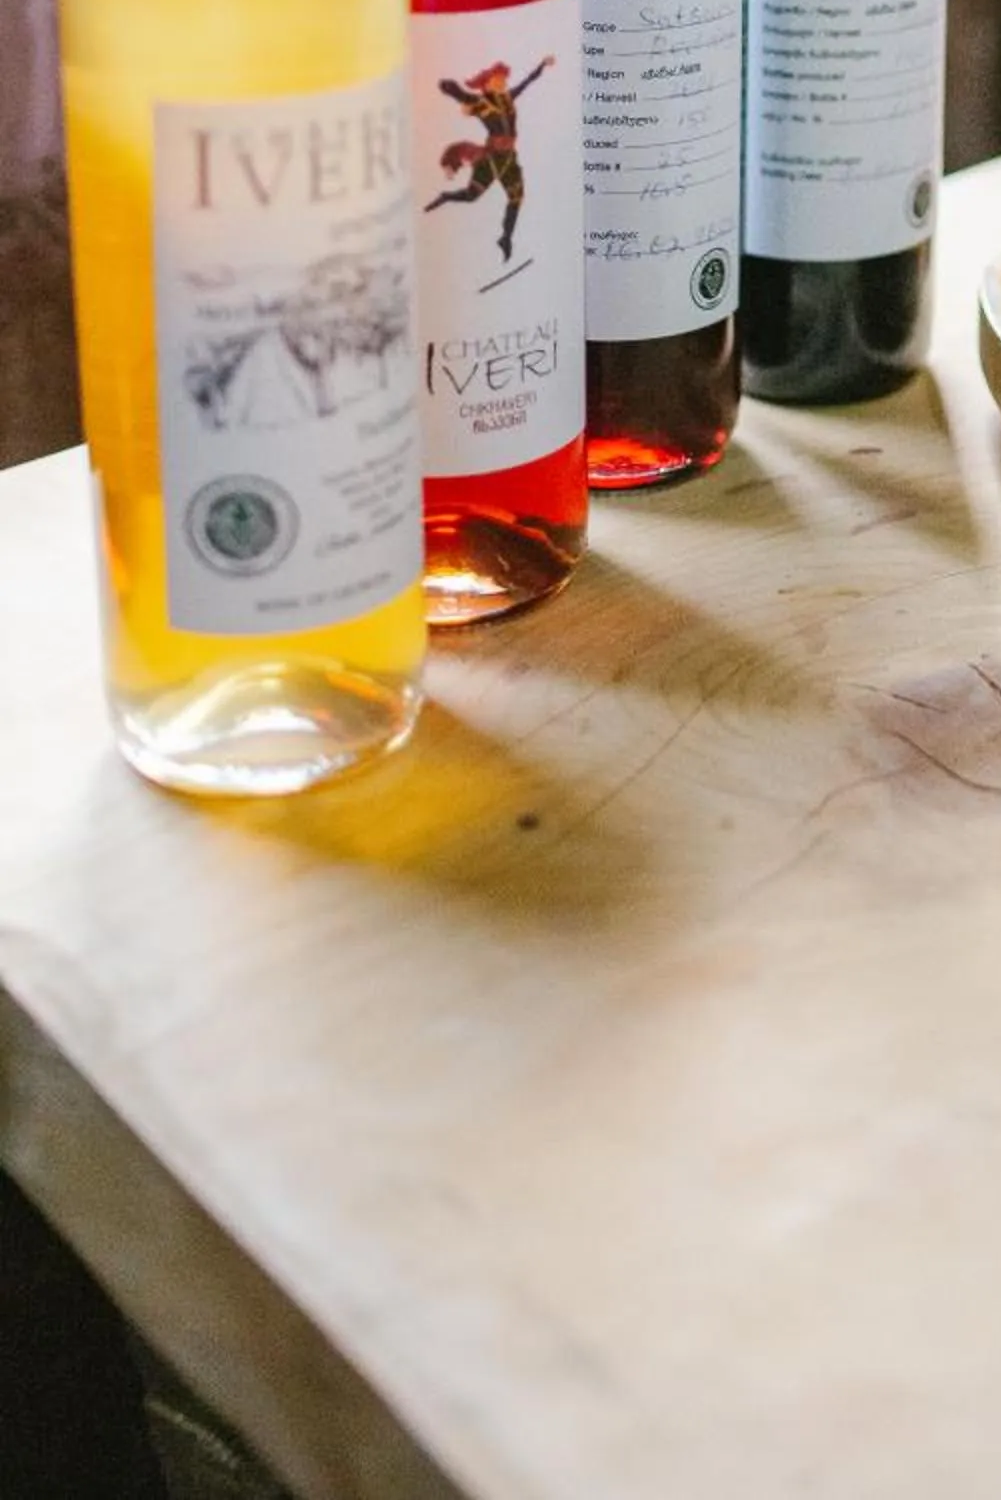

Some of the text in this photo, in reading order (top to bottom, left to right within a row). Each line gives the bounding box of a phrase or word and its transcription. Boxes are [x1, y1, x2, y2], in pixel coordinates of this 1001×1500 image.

[582, 21, 617, 33] Grape
[587, 67, 625, 80] Region
[595, 91, 637, 103] Harvest
[426, 339, 557, 397] IVERI
